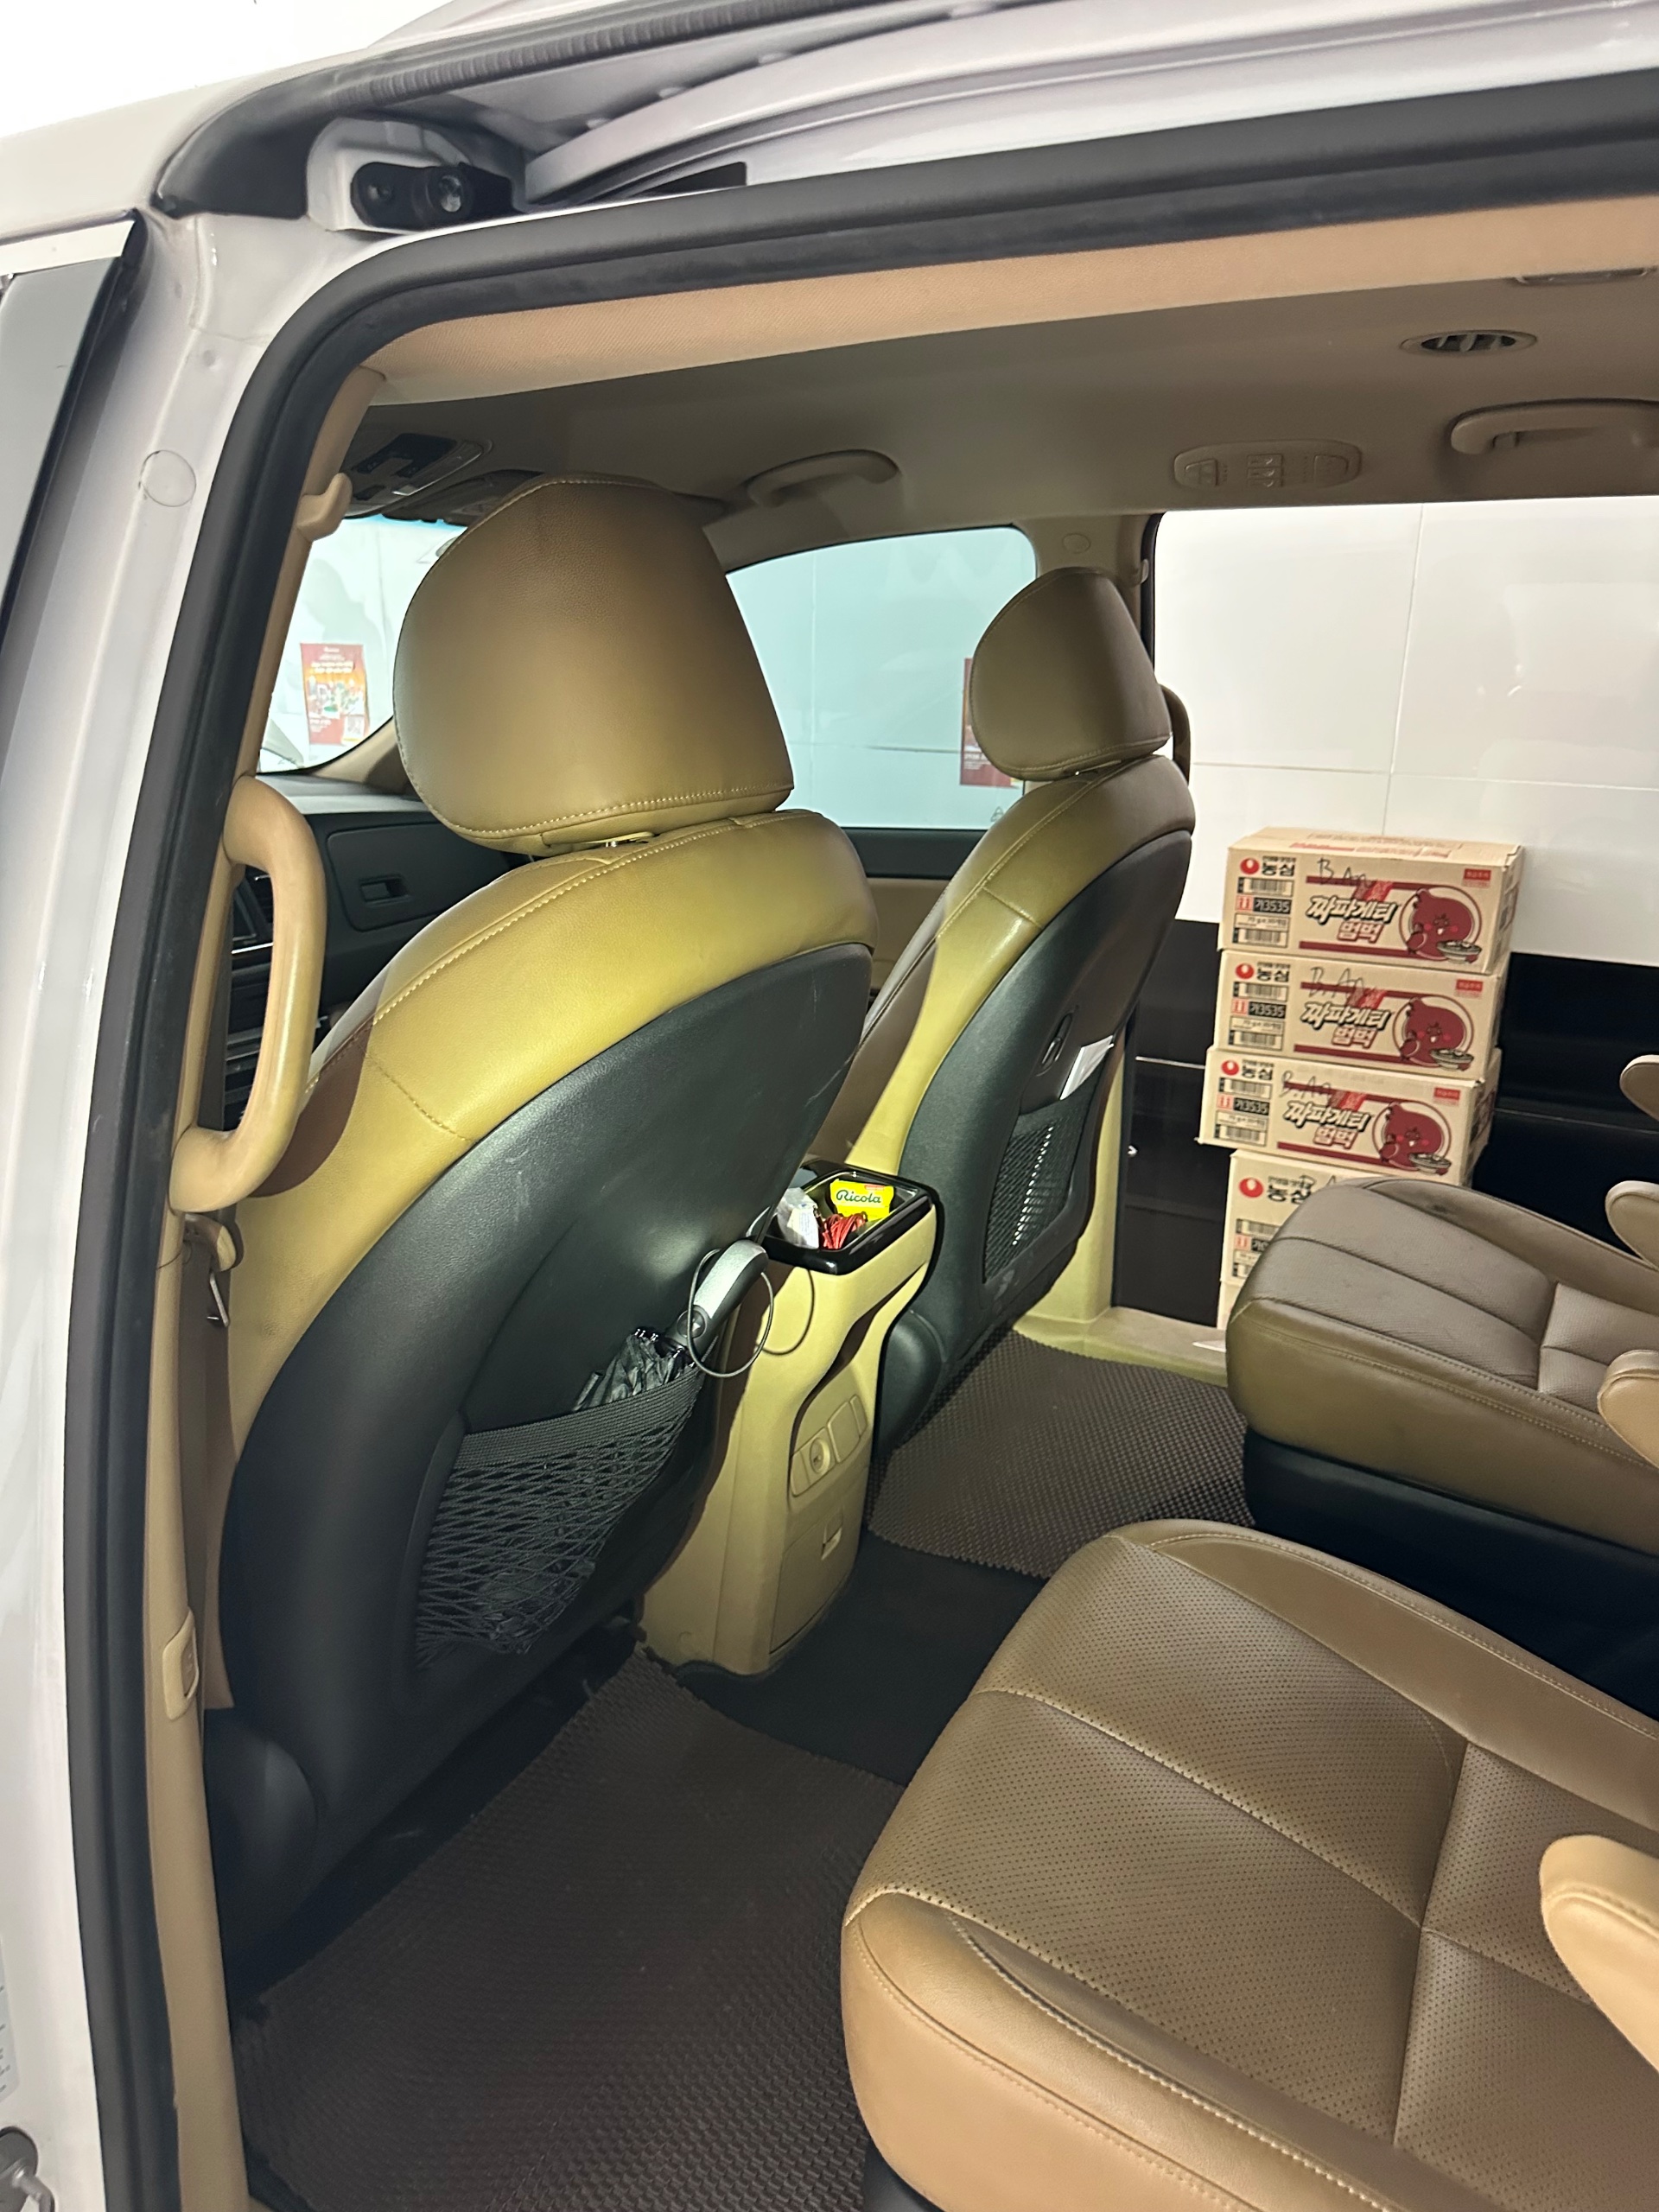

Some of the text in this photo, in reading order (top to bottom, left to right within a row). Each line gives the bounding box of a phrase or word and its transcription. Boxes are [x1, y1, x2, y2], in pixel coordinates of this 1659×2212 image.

[1262, 862, 1294, 877] 농심
[1306, 894, 1399, 925] 짜파게티
[1338, 921, 1385, 944] 범벅
[1256, 968, 1289, 982] 농심
[1300, 1001, 1391, 1031] 짜파게티
[1332, 1025, 1378, 1049] 범벅
[1242, 1065, 1272, 1080] 농심
[1283, 1100, 1371, 1132] 짜파게티
[1313, 1126, 1359, 1149] 범벅
[836, 1189, 881, 1204] Ricola
